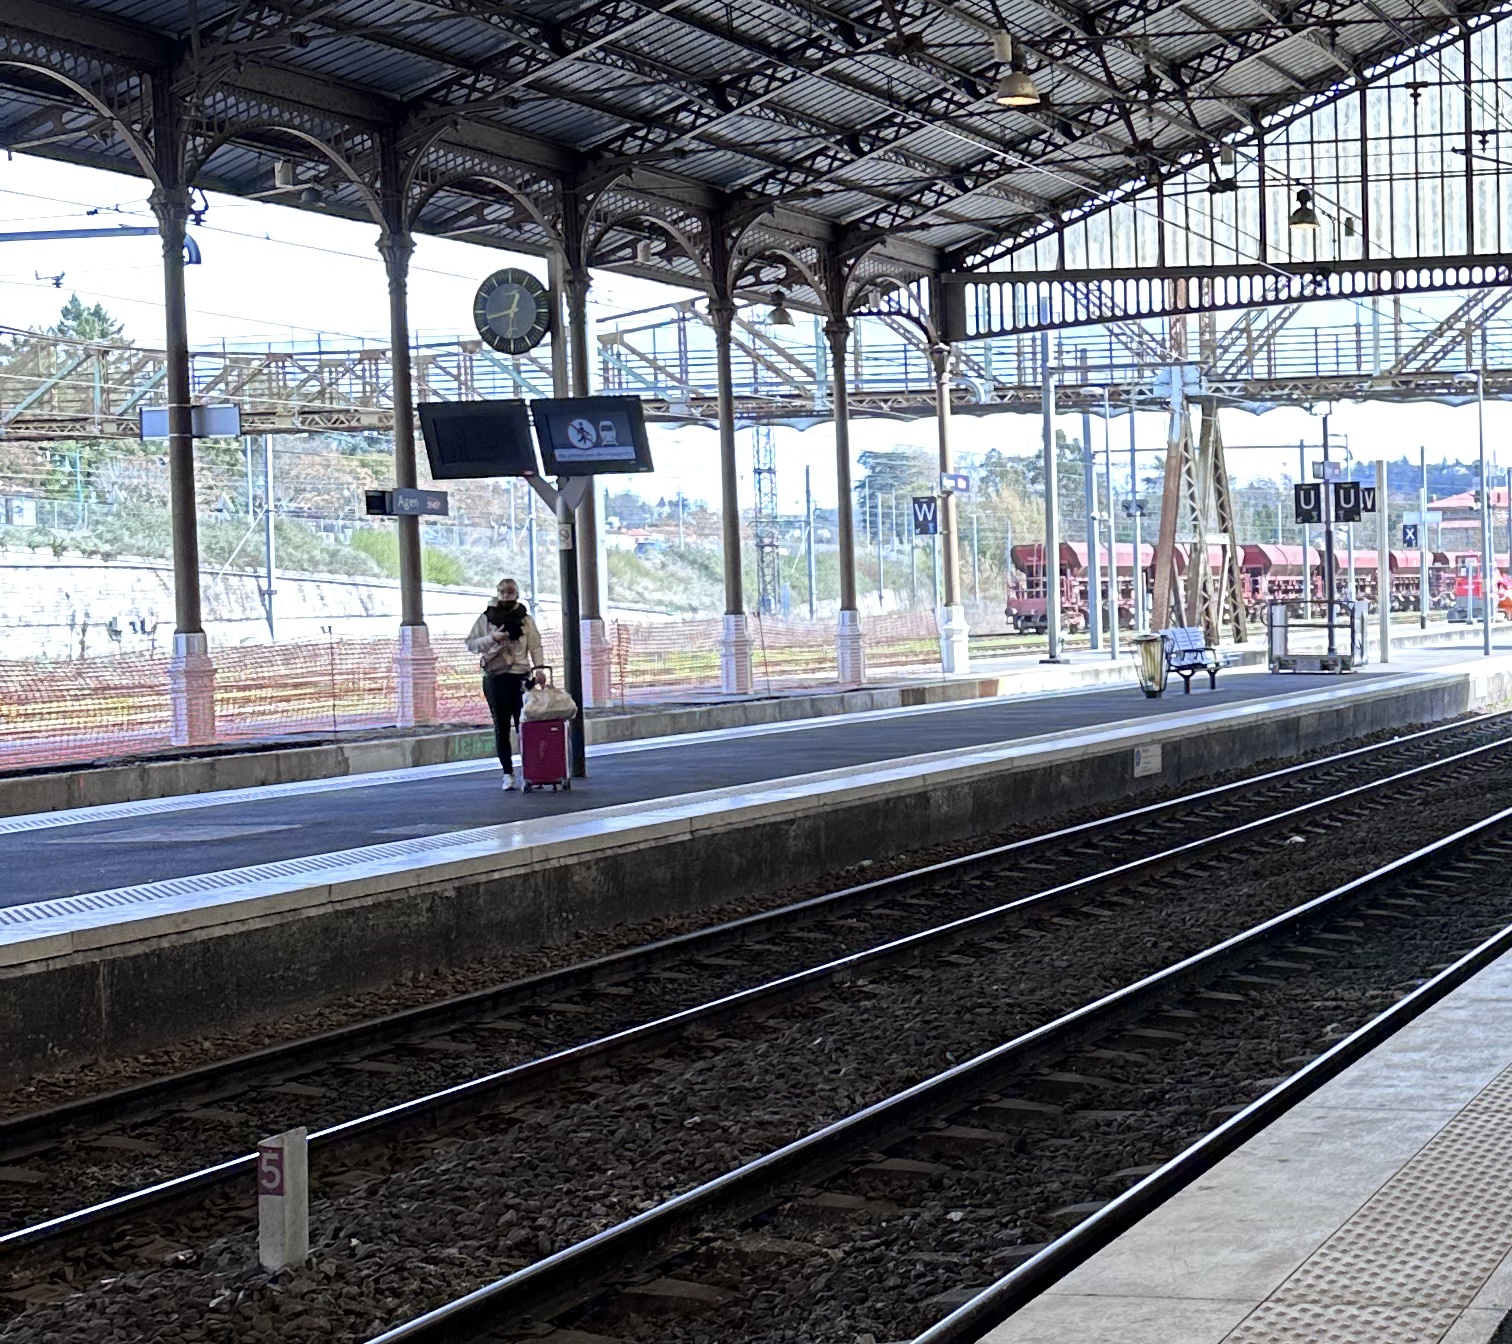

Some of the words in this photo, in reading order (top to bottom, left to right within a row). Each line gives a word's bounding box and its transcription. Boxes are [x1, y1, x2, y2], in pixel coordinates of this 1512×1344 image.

[397, 495, 420, 511] Agen
[1300, 490, 1315, 510] U
[1340, 488, 1354, 508] U
[1364, 490, 1374, 509] V
[914, 503, 935, 521] W
[1405, 528, 1415, 540] X
[261, 1153, 281, 1189] 5
